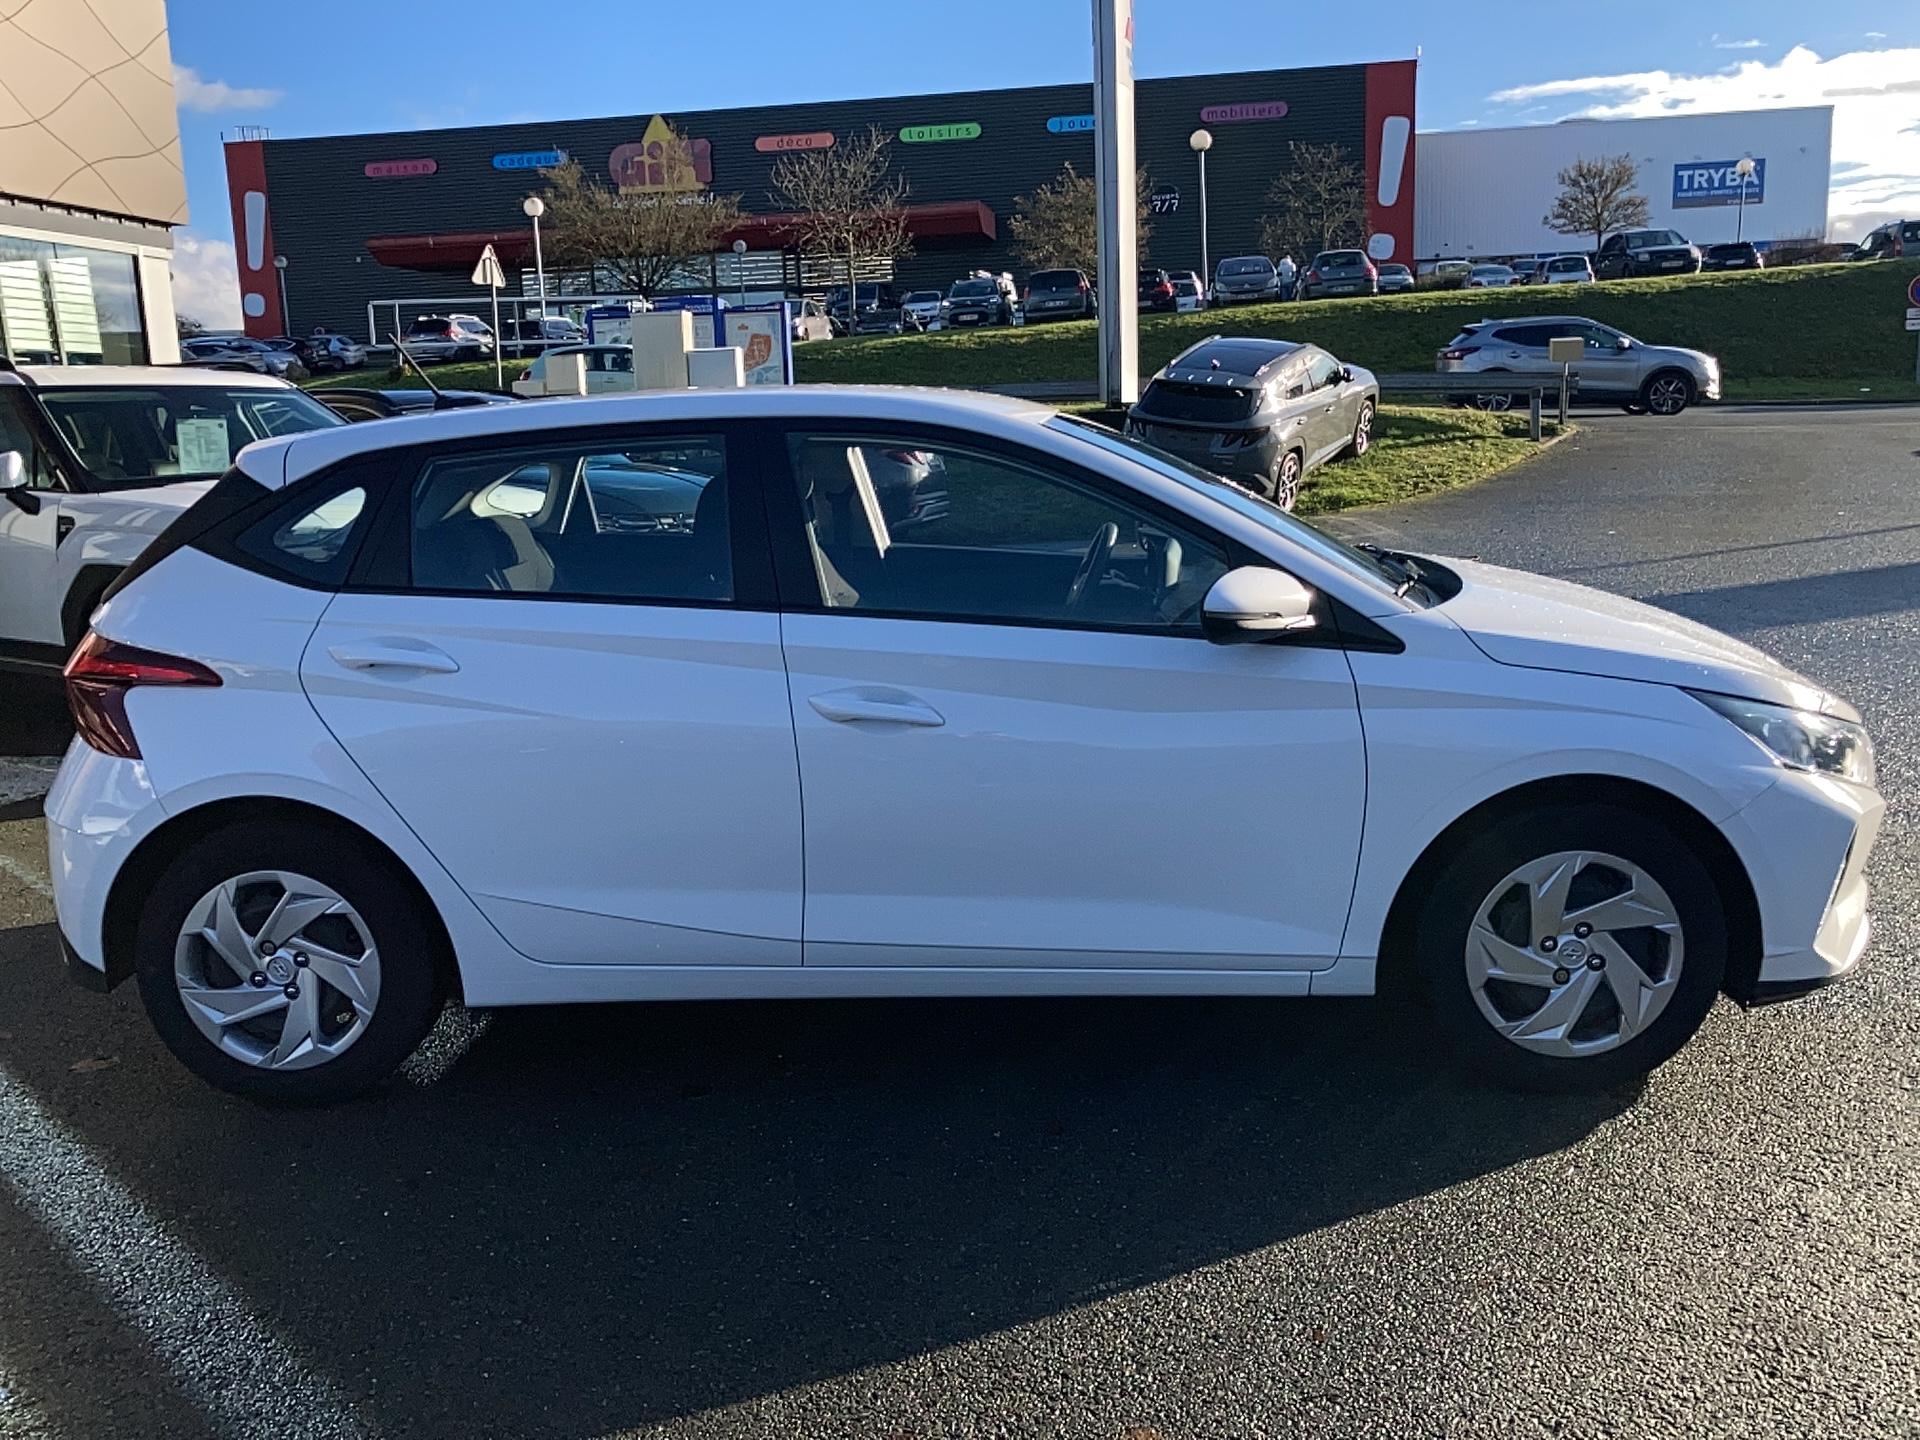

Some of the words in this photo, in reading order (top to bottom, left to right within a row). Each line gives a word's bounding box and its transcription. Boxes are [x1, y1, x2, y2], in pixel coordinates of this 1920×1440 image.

[1206, 103, 1282, 119] mobiliers
[908, 126, 972, 139] loisirs
[373, 163, 430, 175] maison
[1678, 167, 1760, 189] TRYBA
[1152, 199, 1178, 212] 7/7
